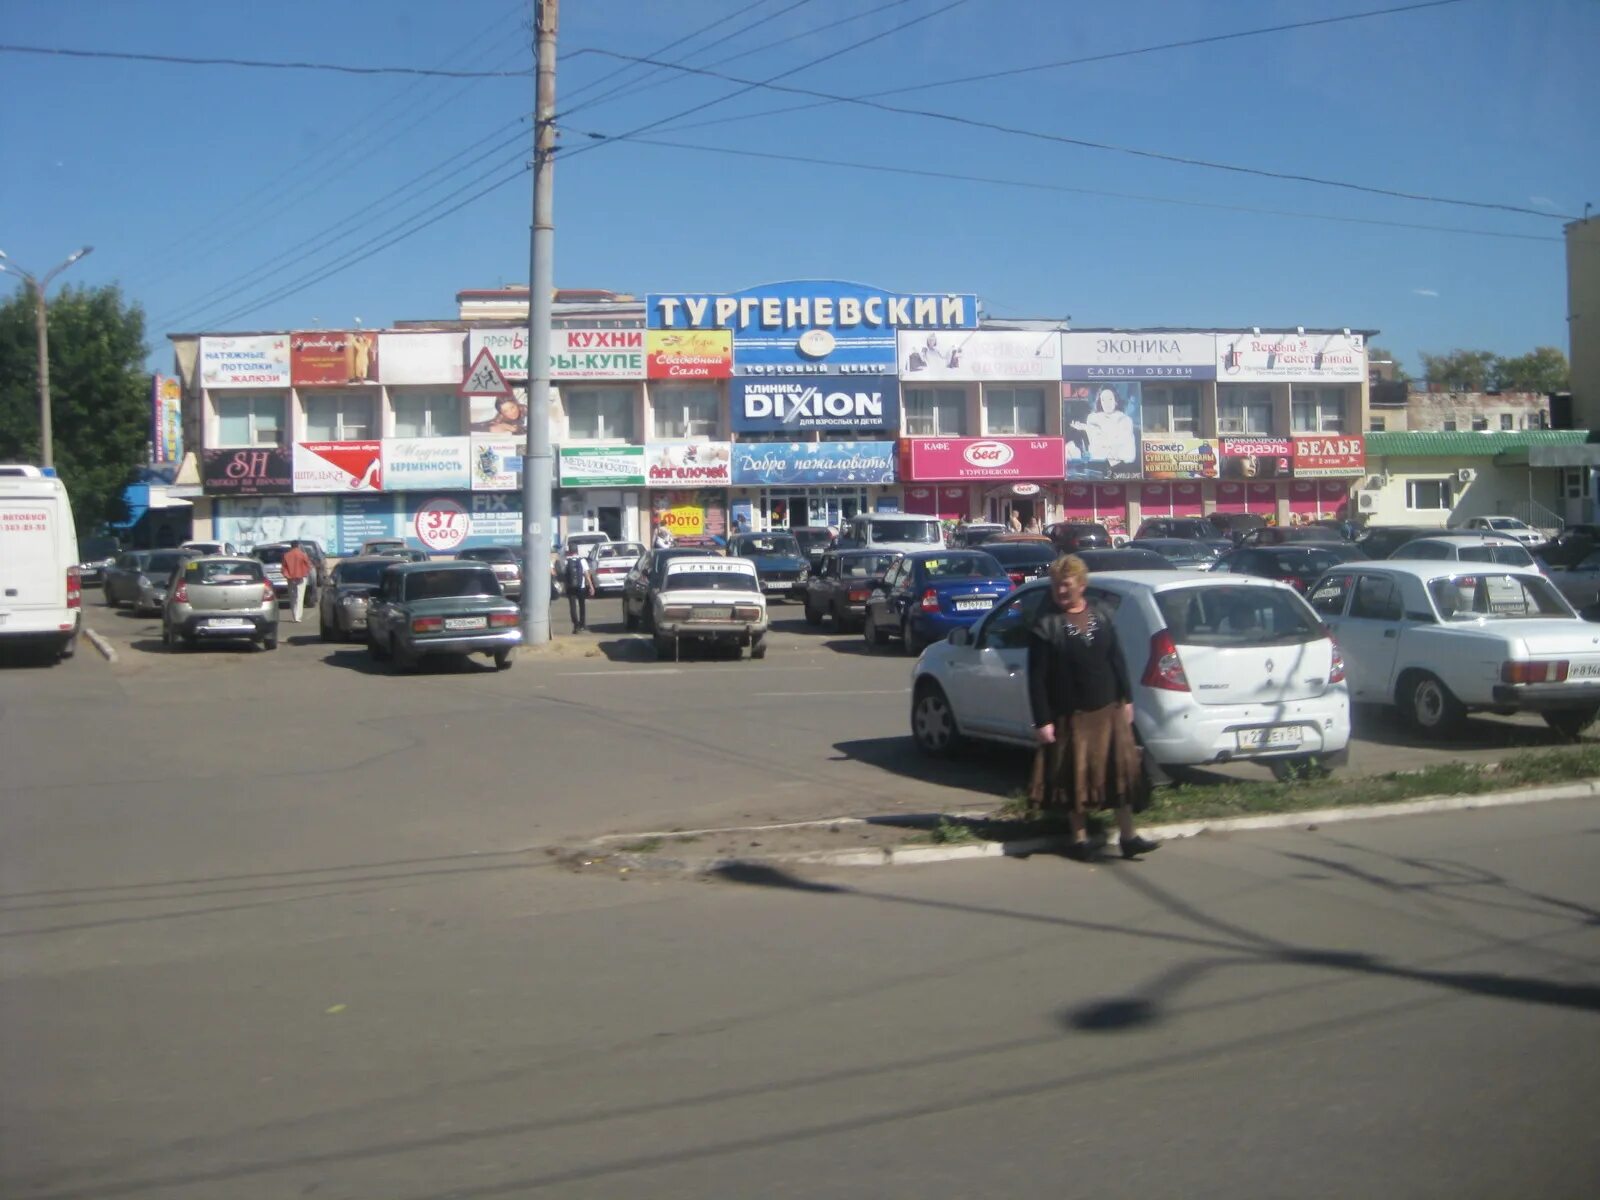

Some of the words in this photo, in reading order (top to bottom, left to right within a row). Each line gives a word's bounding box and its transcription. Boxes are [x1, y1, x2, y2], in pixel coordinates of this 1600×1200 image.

[657, 293, 966, 329] ТУРГЕНЕВСКИЙ
[567, 332, 643, 347] КУХНИ
[1096, 339, 1182, 354] ЭКОНИКА
[495, 354, 642, 369] ШКЫ-КУПЕ
[656, 354, 723, 365] Свадебный
[221, 363, 273, 371] ПОТОЛКИ
[670, 365, 708, 375] Салон
[746, 363, 828, 373] ТОРГОВЫЙ
[841, 364, 886, 373] ЦЕНТР
[1087, 367, 1135, 375] САЛОН
[1145, 367, 1193, 375] ОБУВИ
[745, 384, 803, 393] КЛИНИКА
[745, 387, 882, 424] DIXION
[861, 417, 883, 425] ДЕТЕЙ
[1224, 443, 1288, 456] Рафаэль
[1296, 440, 1361, 456] БЕЛЬЕ
[226, 452, 269, 478] SH
[390, 462, 463, 471] БЕРЕМЕННОСТЬ
[740, 452, 786, 477] Добро
[794, 453, 894, 470] пожаловать!
[1280, 458, 1288, 468] 2
[472, 495, 508, 511] FIX
[428, 511, 457, 528] 37
